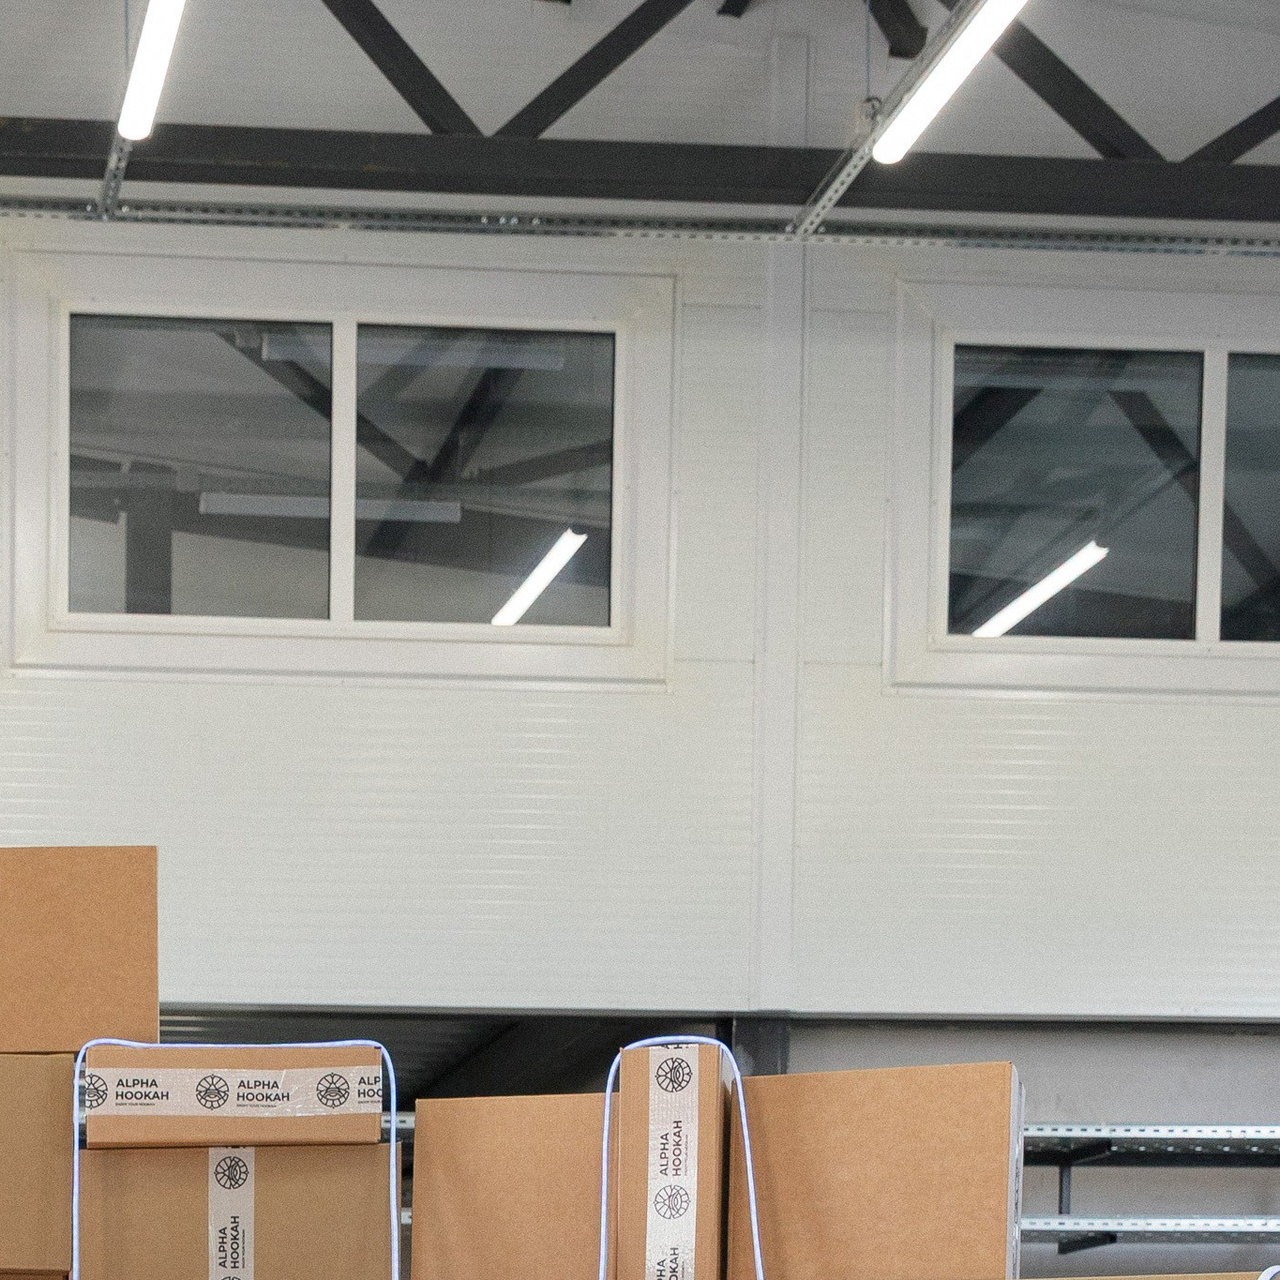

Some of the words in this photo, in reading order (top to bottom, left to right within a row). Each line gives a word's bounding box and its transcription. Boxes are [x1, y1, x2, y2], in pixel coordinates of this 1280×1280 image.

[115, 1090, 170, 1101] HOOKAH
[116, 1078, 159, 1089] ALPHA
[236, 1091, 290, 1102] HOOKAH
[237, 1079, 280, 1090] ALPHA
[659, 1132, 669, 1177] ALPHA
[672, 1120, 683, 1177] HOOKAH
[219, 1227, 228, 1269] ALPHA
[231, 1216, 240, 1270] HOOKAH
